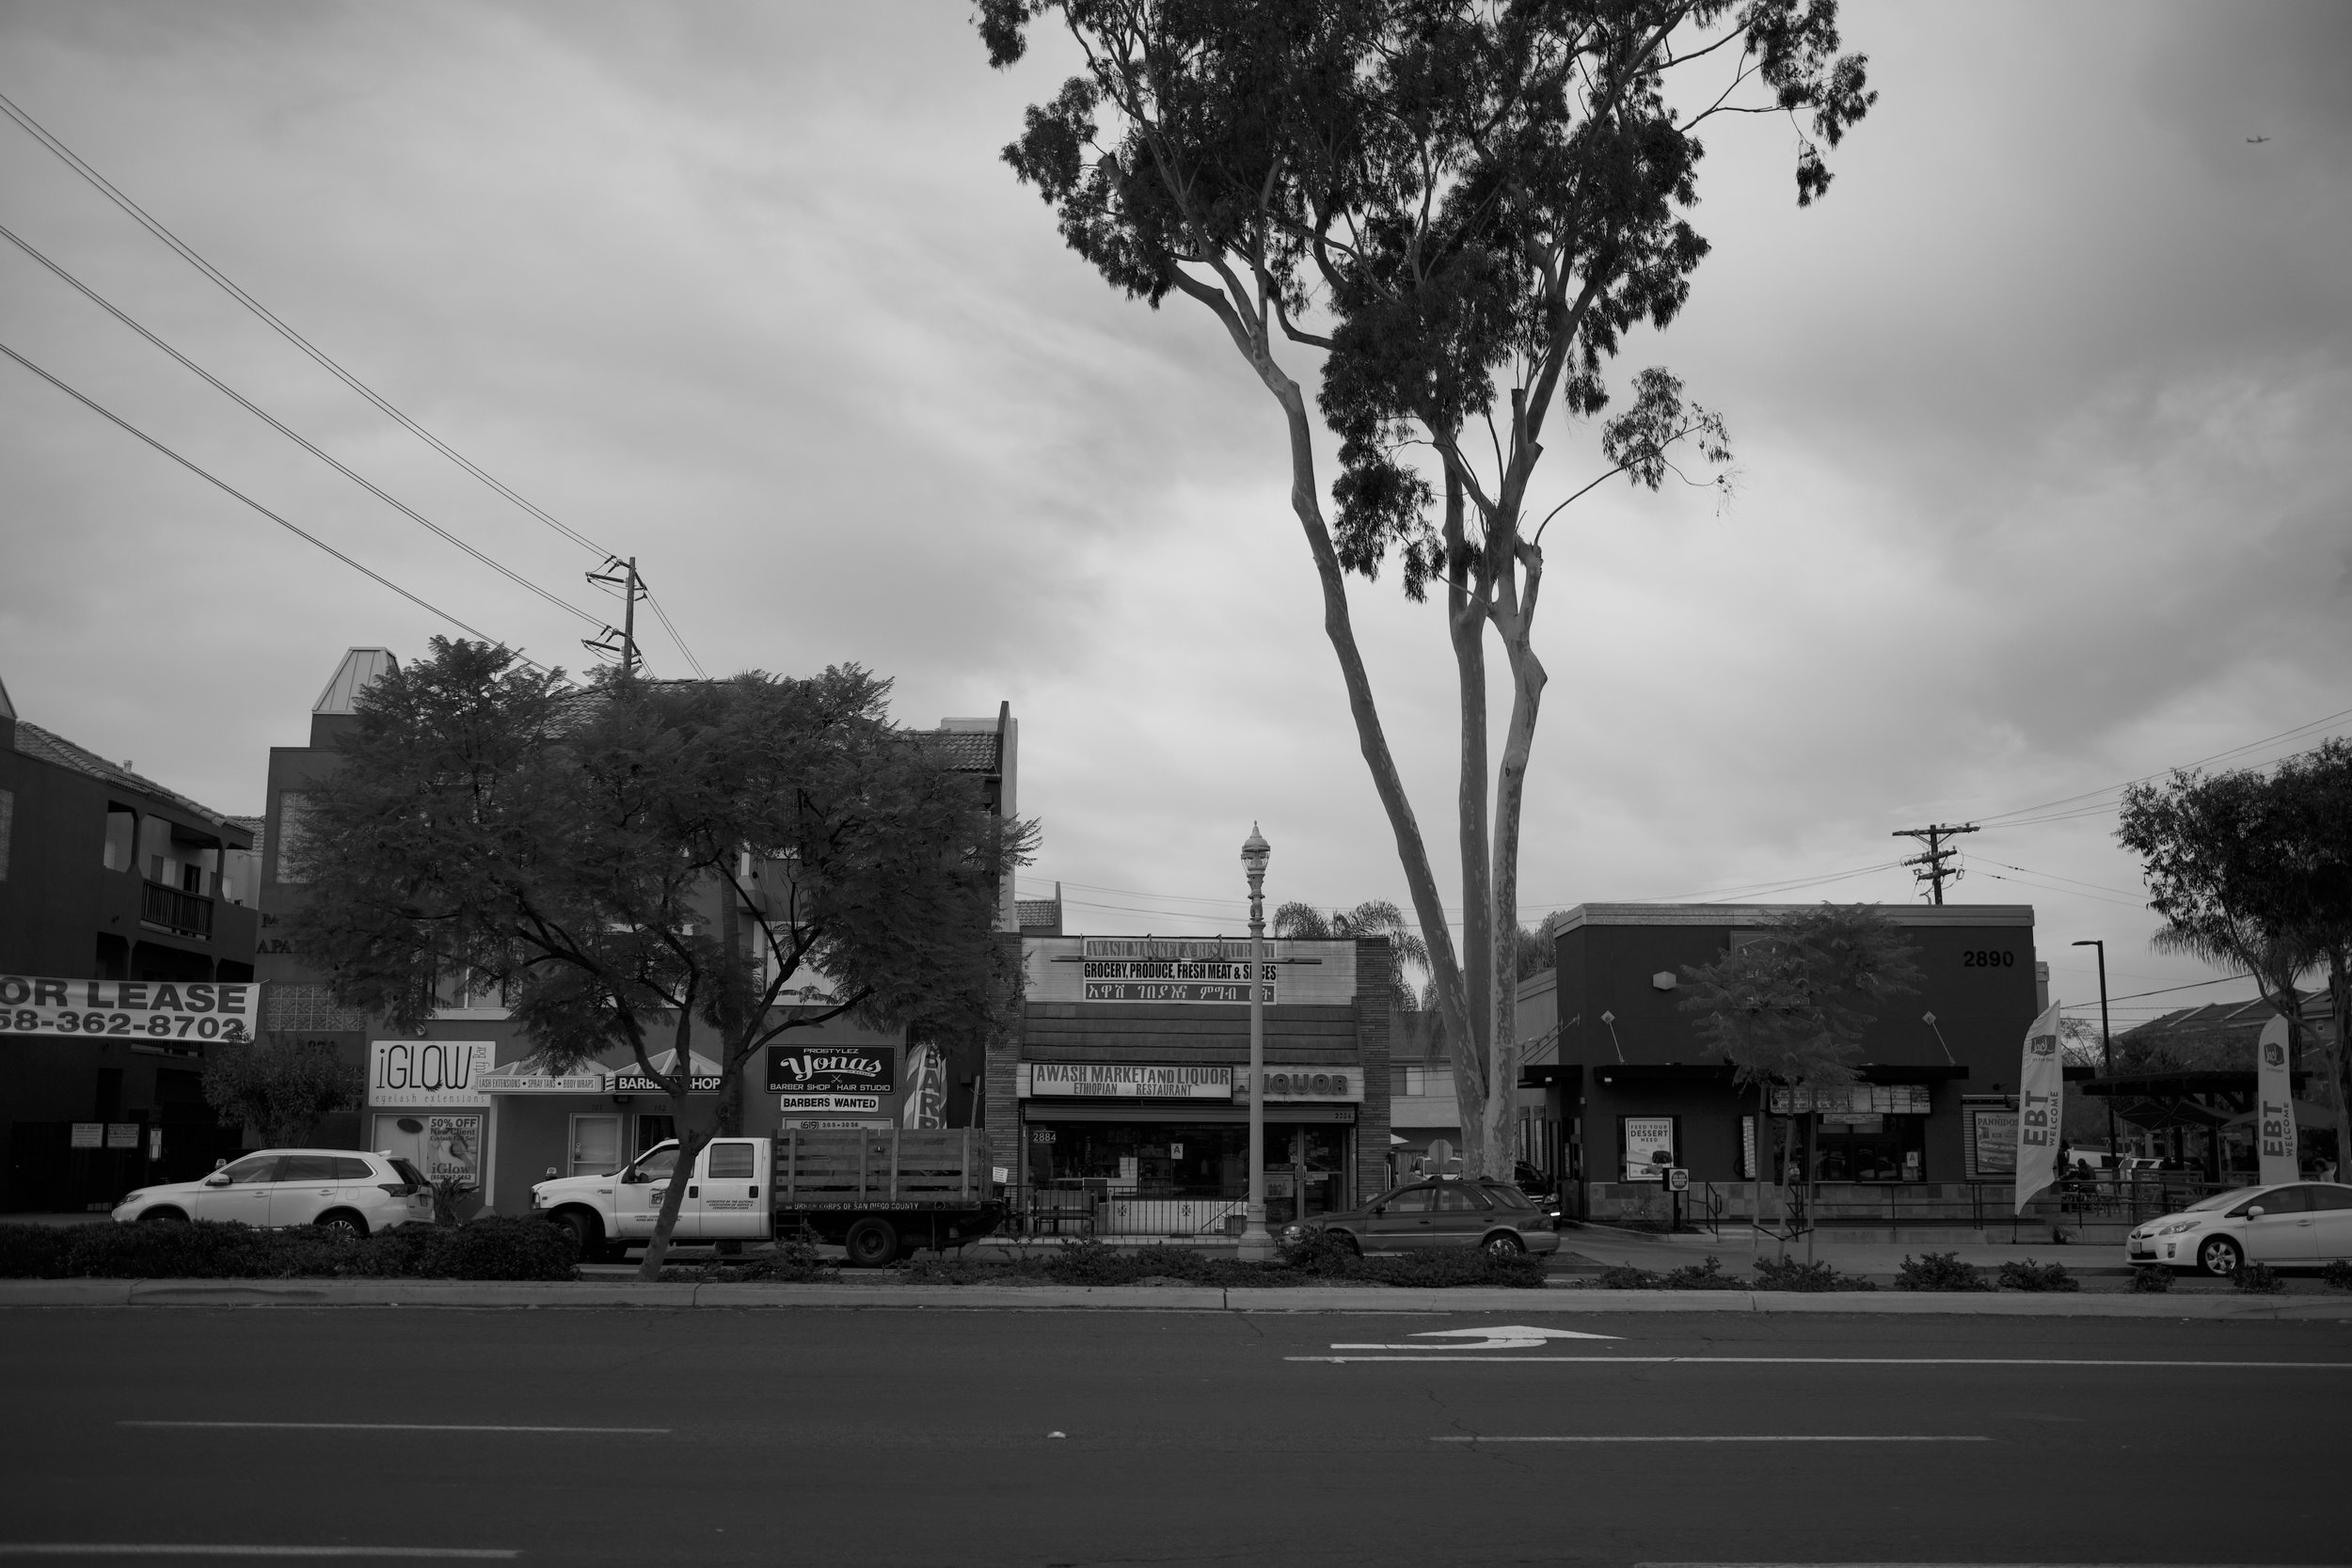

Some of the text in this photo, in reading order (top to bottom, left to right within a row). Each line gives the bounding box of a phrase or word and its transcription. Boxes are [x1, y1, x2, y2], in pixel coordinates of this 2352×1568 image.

[1088, 942, 1127, 957] AWASH
[1131, 942, 1181, 958] MARKET
[1196, 942, 1274, 958] RESTAURT
[1963, 950, 2014, 967] 2890
[1084, 962, 1277, 980] GROCERY, PRODUCE, FRESH MEAT & SES
[87, 981, 247, 1014] LEASE
[780, 1054, 882, 1082] Yonas
[1036, 1065, 1229, 1086] AWASH MARKET AND LIQUOR
[479, 1079, 491, 1088] LASH
[492, 1079, 521, 1088] EXTENSIONS
[527, 1079, 543, 1088] SPRAY
[577, 1079, 595, 1088] WRAPS
[618, 1077, 722, 1089] BARB HOP
[1073, 1083, 1192, 1097] ETHIOPIAN RESTAURANT
[1249, 1073, 1348, 1095] IQUOR
[376, 1094, 485, 1104] eyelash extensions
[784, 1098, 877, 1108] BARBERS WANTED
[431, 1118, 477, 1128] 50% OFF
[2024, 1091, 2048, 1146] EBT
[2049, 1091, 2058, 1147] WELCOME
[1033, 1132, 1056, 1142] 2884
[2264, 1101, 2283, 1156] EBT
[2282, 1101, 2293, 1157] WELCOME
[433, 1163, 469, 1174] iGlow
